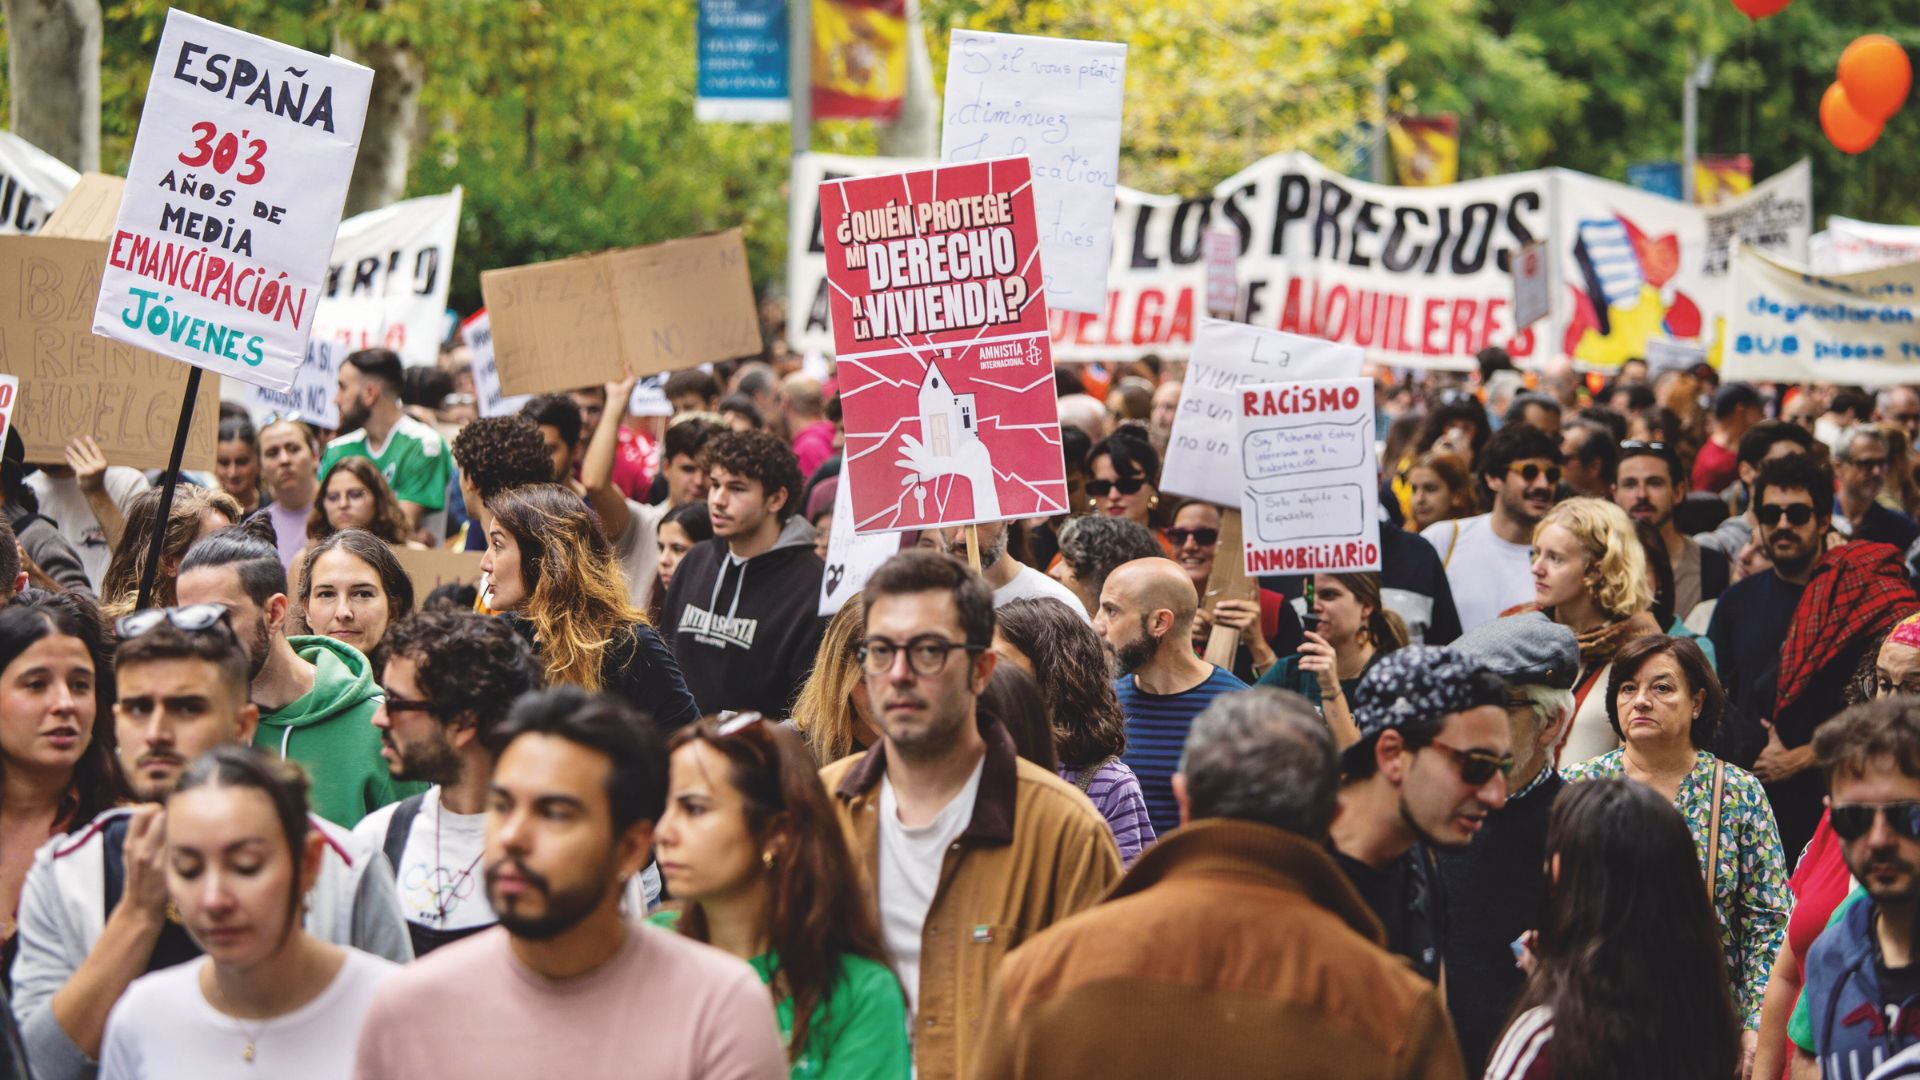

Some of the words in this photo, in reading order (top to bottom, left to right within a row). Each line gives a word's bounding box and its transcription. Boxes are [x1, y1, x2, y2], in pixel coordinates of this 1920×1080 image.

[174, 41, 335, 134] ESPAÑA
[1032, 61, 1072, 74] vous
[949, 81, 1069, 144] diminuez
[178, 121, 268, 185] 30'3
[158, 170, 236, 207] AÑOS
[252, 200, 287, 225] DE
[837, 199, 916, 245] ¿QUIÉN
[918, 192, 1013, 236] PROTEGE
[1131, 183, 1258, 270] LOS
[1270, 174, 1540, 275] PRECIOS
[846, 245, 867, 271] MI
[866, 227, 1017, 292] DERECHO
[122, 287, 265, 367] JÓVENES
[853, 296, 866, 319] A
[854, 319, 872, 341] LA
[866, 275, 1028, 339] VIVIENDA?
[1050, 287, 1195, 347] UELGA
[980, 341, 1023, 360] AMNISTÍA
[980, 357, 1025, 370] INTERNACIONAL
[1251, 335, 1291, 368] La
[18, 380, 215, 454] HUELGA
